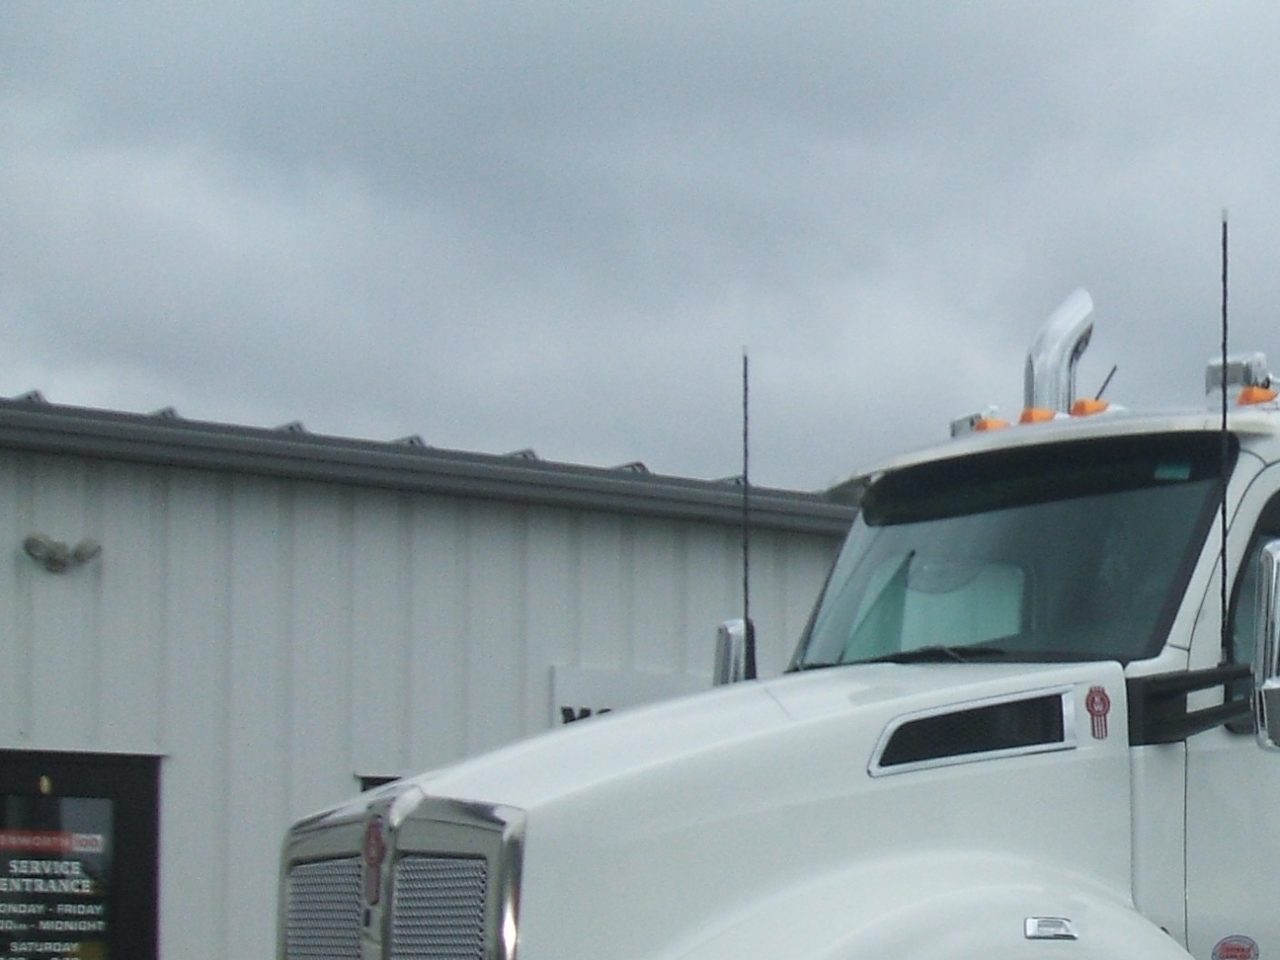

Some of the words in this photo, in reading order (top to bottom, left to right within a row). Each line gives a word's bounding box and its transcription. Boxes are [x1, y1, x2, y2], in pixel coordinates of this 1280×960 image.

[8, 860, 81, 875] SERVICE
[0, 878, 91, 893] ENTRANCE
[0, 903, 45, 914] ONDAY
[56, 903, 103, 915] FRIDAY
[38, 920, 106, 932] MIDNIGHT
[9, 941, 80, 953] SATURDAY
